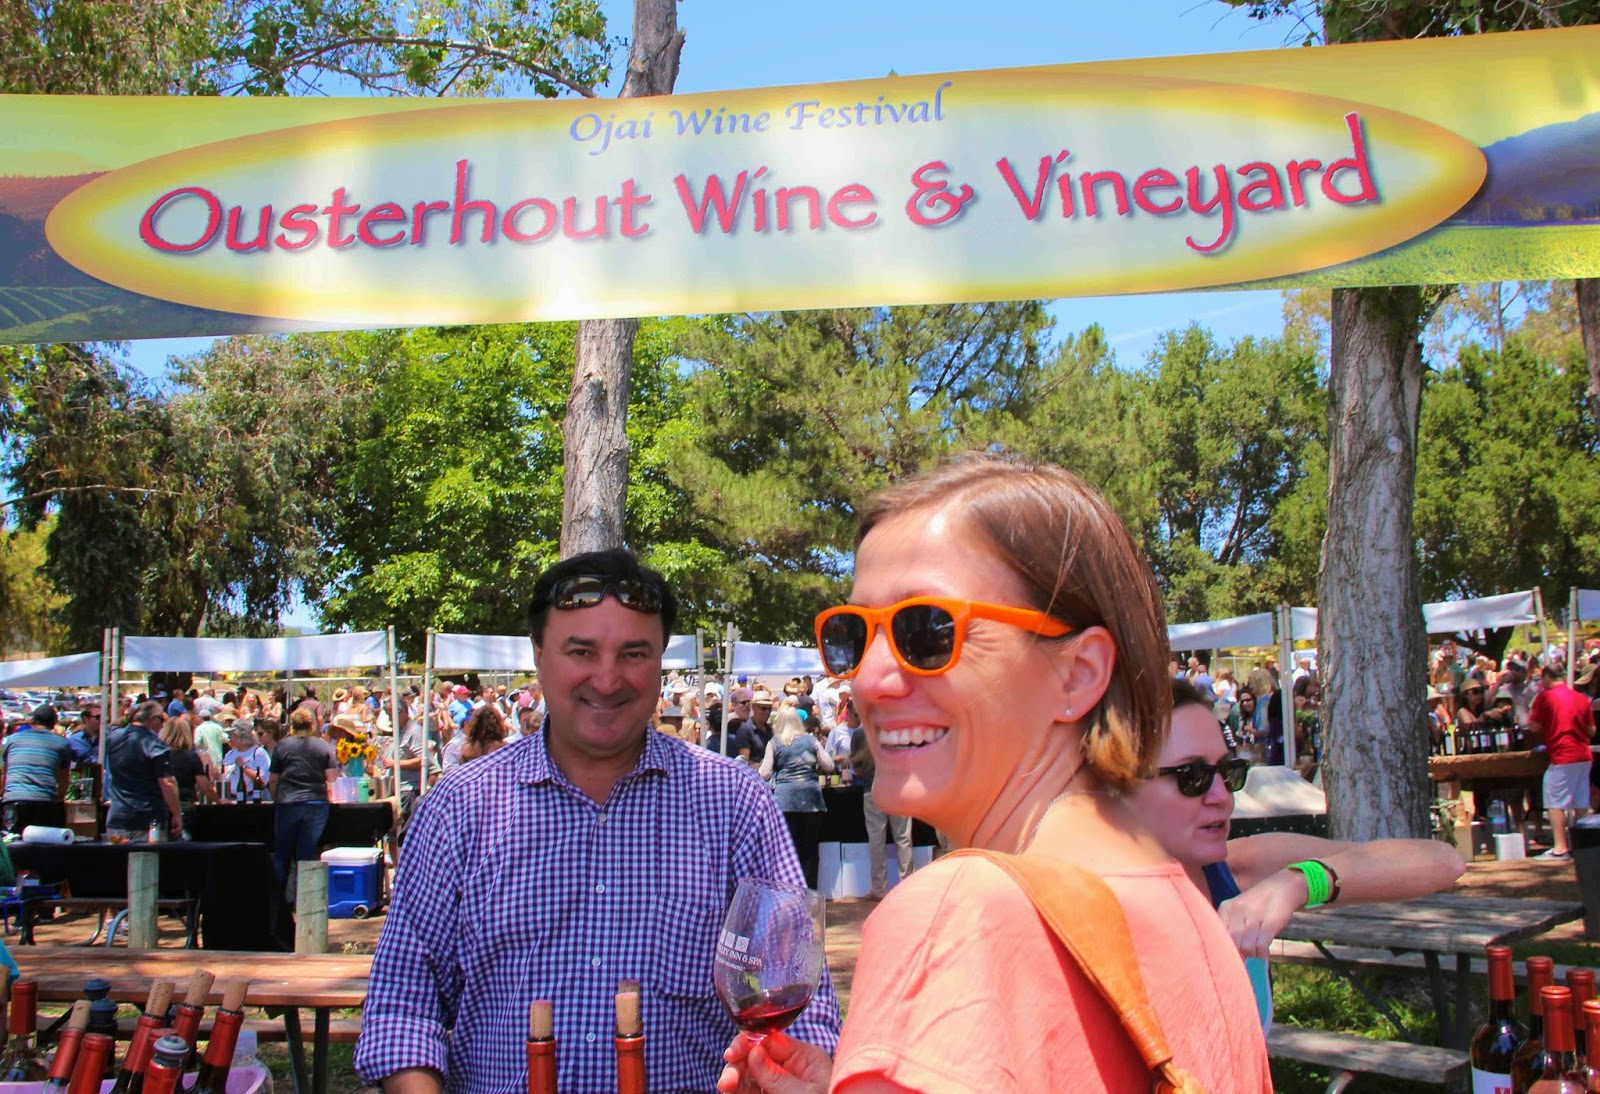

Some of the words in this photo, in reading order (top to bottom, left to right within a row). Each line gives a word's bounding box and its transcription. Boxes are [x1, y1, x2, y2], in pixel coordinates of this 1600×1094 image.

[569, 112, 655, 156] Ojai
[668, 106, 770, 137] Wine
[784, 81, 953, 131] Festival
[139, 159, 651, 253] Ousterhout
[673, 165, 879, 234] Wine
[905, 160, 976, 226] &
[997, 112, 1378, 253] Vineyard
[748, 955, 763, 967] SPA
